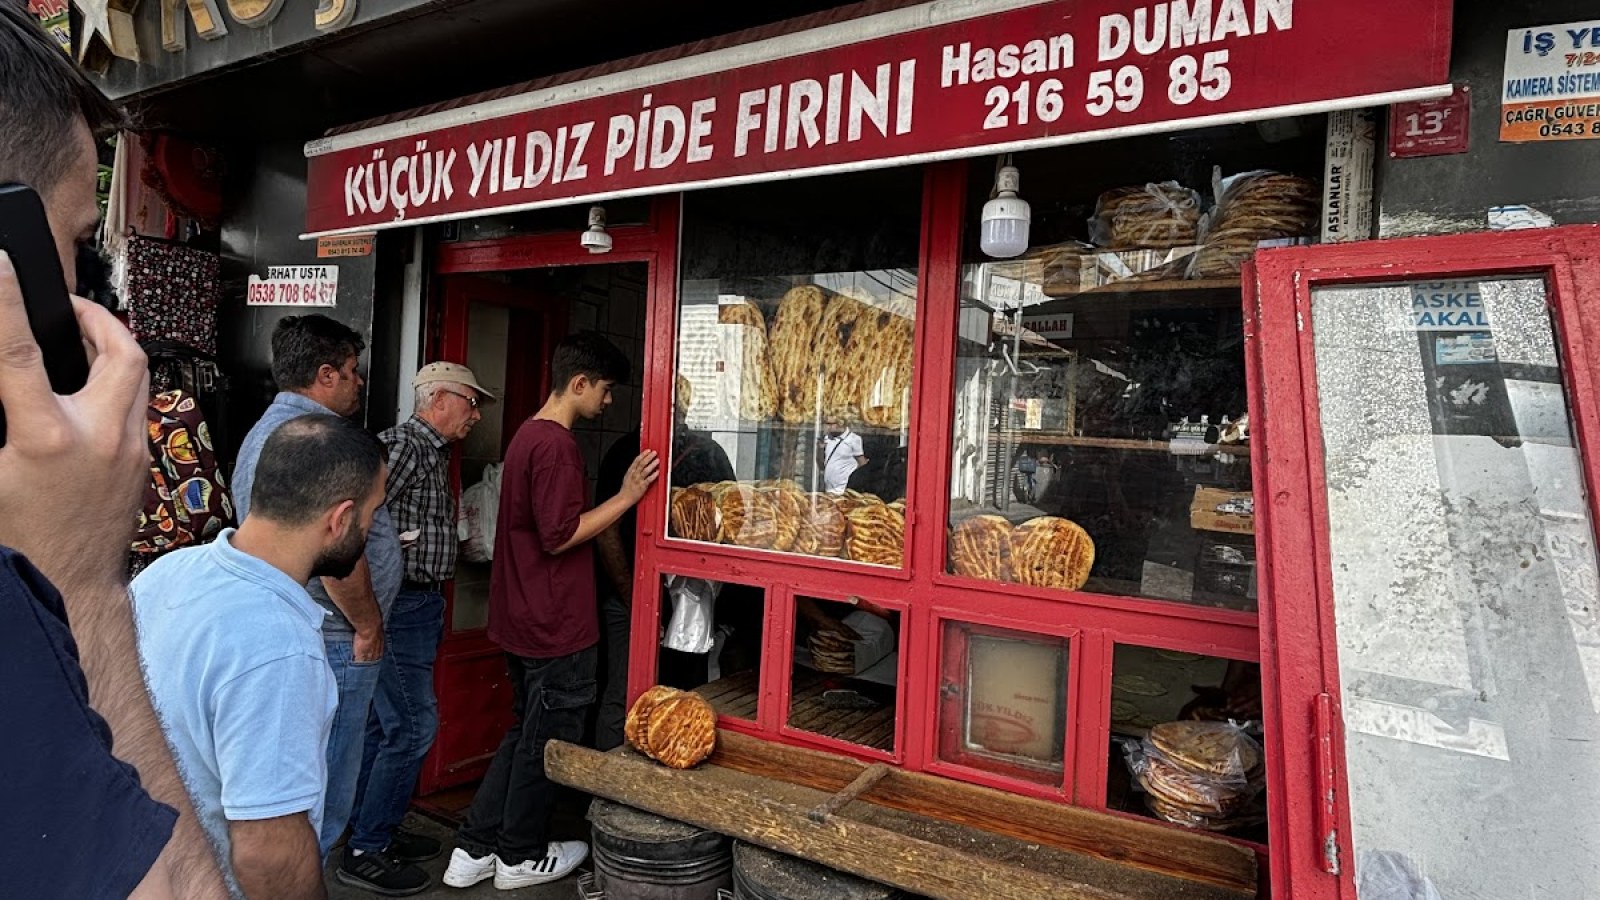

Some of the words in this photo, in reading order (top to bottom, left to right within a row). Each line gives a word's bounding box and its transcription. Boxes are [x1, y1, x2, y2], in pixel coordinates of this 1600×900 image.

[940, 32, 1075, 88] Hasan
[1098, 0, 1294, 61] DUMAN
[1523, 30, 1556, 57] İŞ
[983, 78, 1064, 130] 216
[1085, 65, 1144, 117] 59
[1167, 50, 1232, 105] 85
[1506, 77, 1553, 98] KAMERA
[1506, 106, 1550, 125] ÇAĞRI
[344, 139, 457, 223] KÜÇÜK
[466, 121, 595, 198] YILDIZ
[603, 93, 717, 177] PİDE
[734, 59, 917, 158] FIRINI
[1540, 122, 1585, 137] 0543
[1328, 165, 1342, 234] ASLANLAR
[267, 267, 298, 279] RHAT
[300, 267, 328, 279] USTA
[249, 283, 275, 303] 0538
[279, 283, 299, 303] 708
[303, 283, 317, 303] 64
